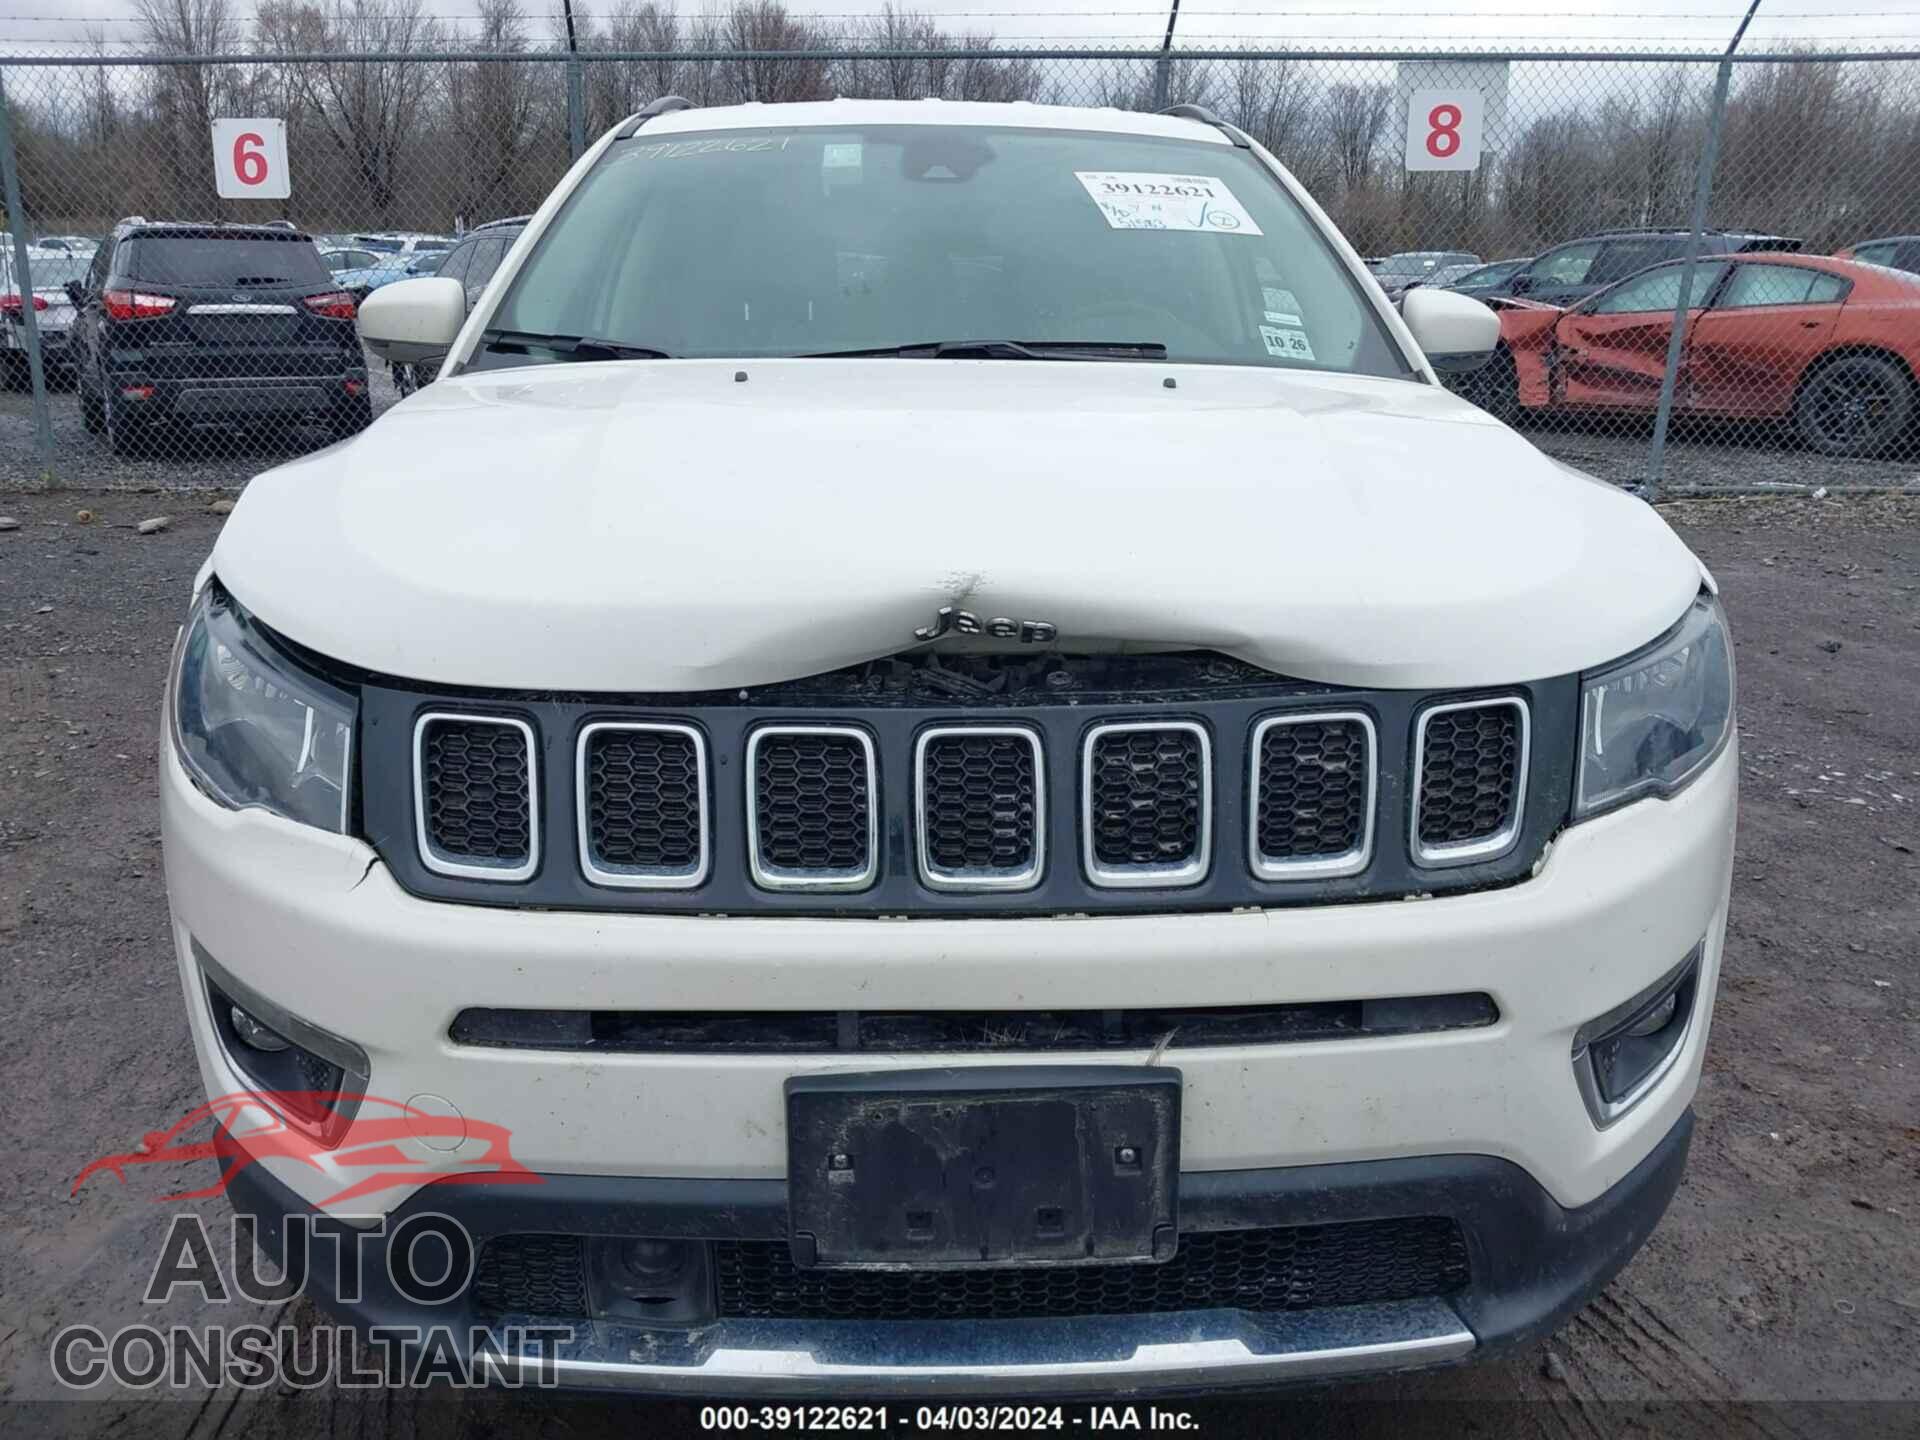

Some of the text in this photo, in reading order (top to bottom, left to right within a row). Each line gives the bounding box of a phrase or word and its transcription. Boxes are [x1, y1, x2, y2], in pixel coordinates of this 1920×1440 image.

[1426, 104, 1462, 157] 8
[233, 132, 268, 185] 6
[1101, 183, 1216, 199] 39122621
[1266, 335, 1307, 351] 10 26
[913, 606, 1057, 643] Jeep
